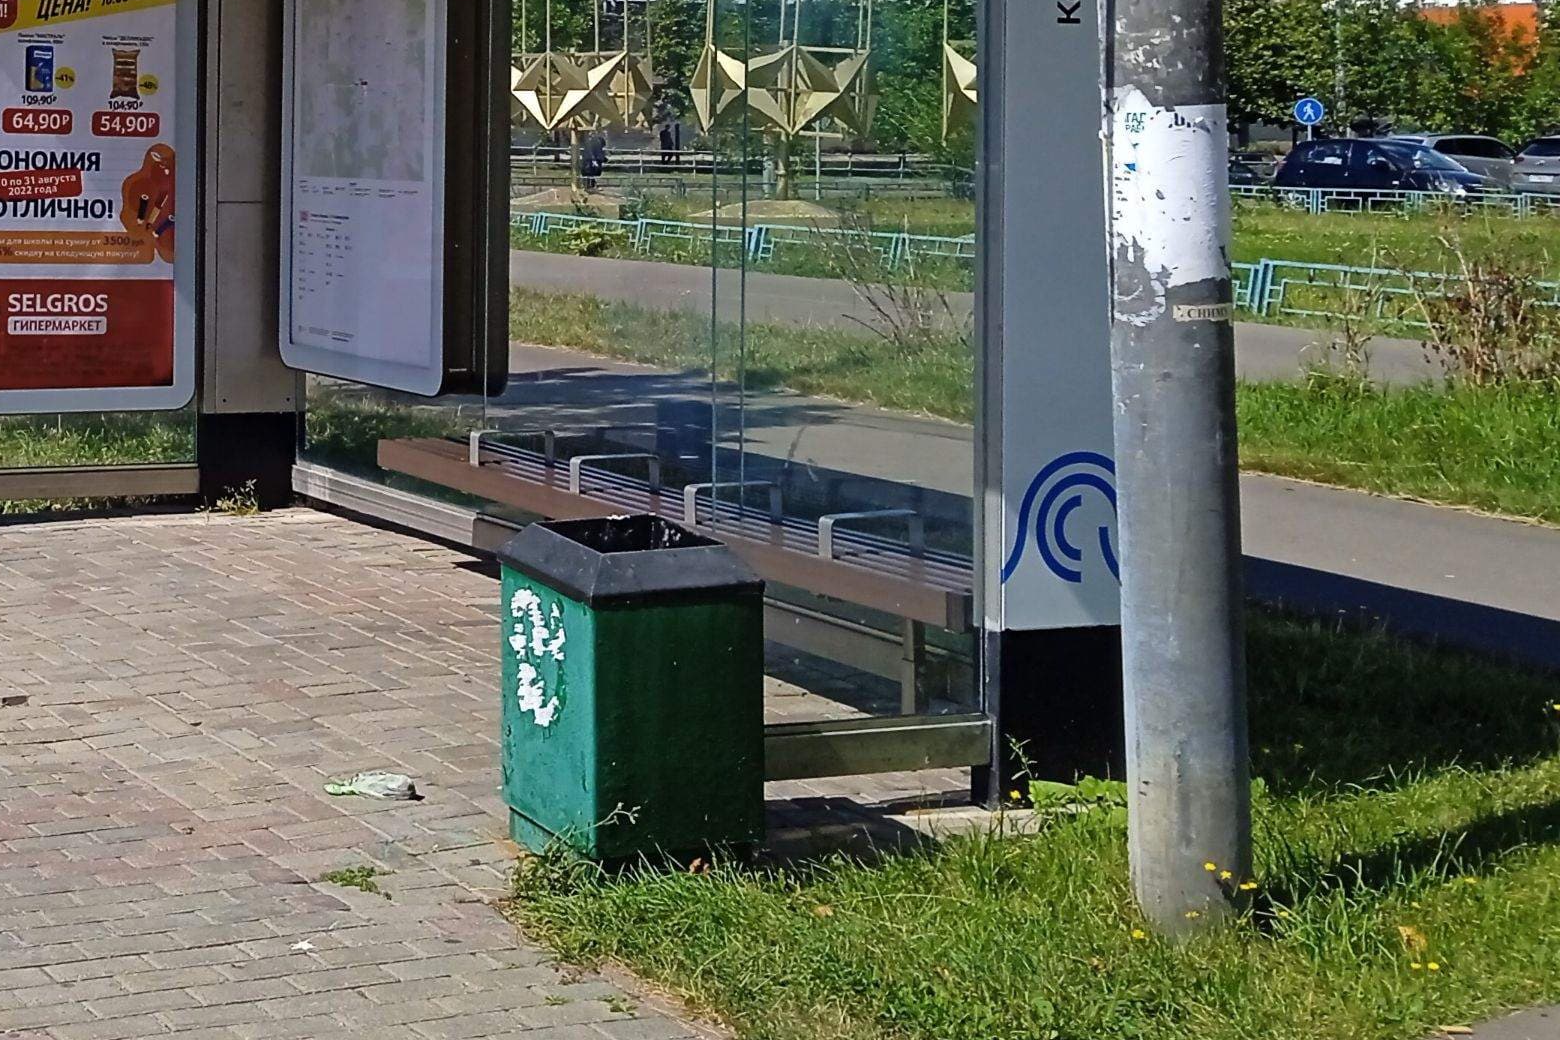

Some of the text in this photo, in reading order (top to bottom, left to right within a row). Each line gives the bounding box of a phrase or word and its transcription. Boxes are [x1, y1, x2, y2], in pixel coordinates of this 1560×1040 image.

[10, 179, 22, 187] по
[24, 176, 36, 185] 31
[38, 174, 77, 186] августа
[8, 186, 58, 196] 2022 года
[103, 235, 130, 246] 3500
[7, 293, 108, 313] SELGROS
[13, 319, 102, 332] ГИПЕРМАРКЕТ
